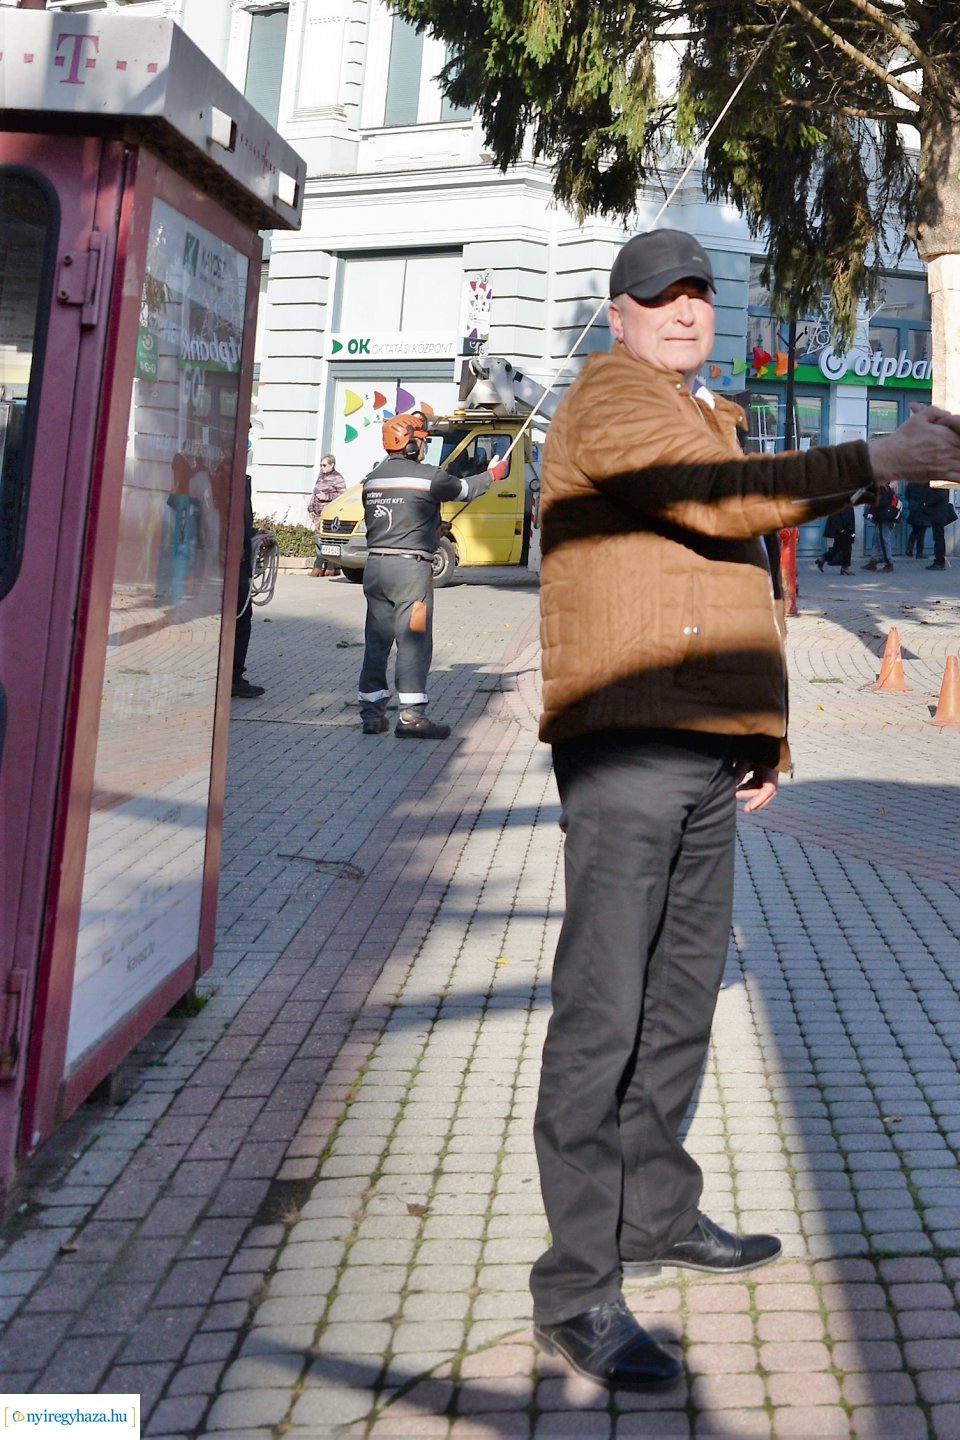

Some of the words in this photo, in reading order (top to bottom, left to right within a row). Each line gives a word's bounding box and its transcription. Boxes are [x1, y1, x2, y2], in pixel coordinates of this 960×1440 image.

[57, 33, 99, 84] T
[347, 338, 371, 355] OK
[854, 349, 932, 386] otpba
